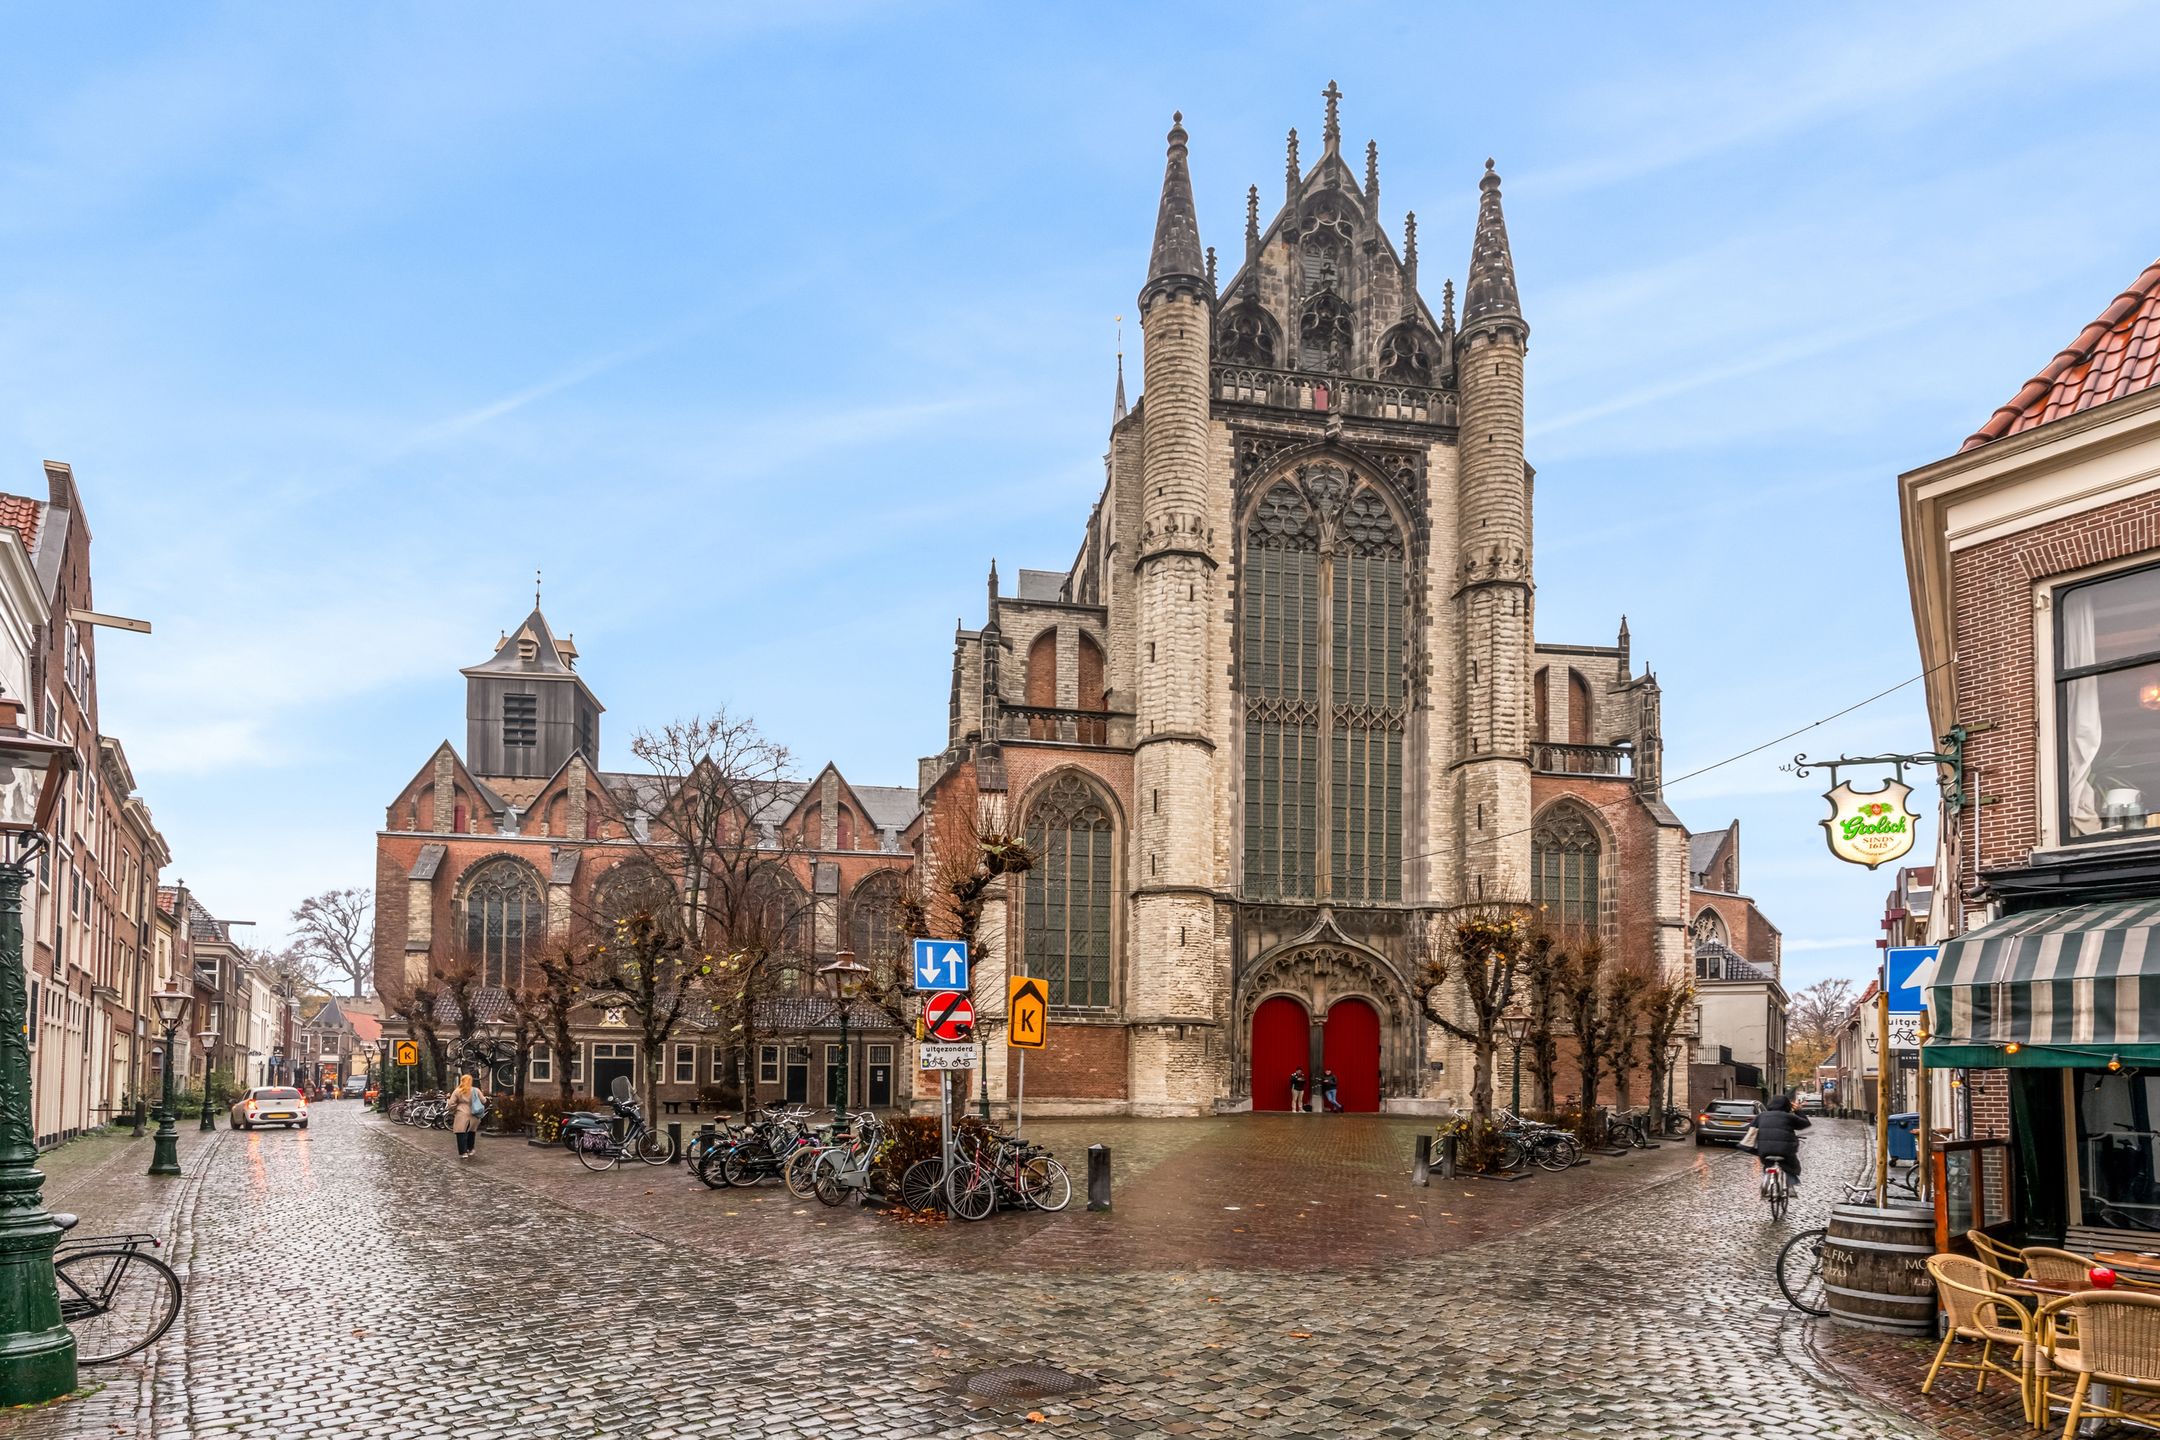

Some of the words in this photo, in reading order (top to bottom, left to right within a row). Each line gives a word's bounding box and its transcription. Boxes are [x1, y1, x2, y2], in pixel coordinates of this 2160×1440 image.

[1840, 815, 1906, 841] Grolsch
[1021, 1009, 1036, 1033] K
[404, 1051, 412, 1060] K
[925, 1045, 973, 1054] uitgezonderd
